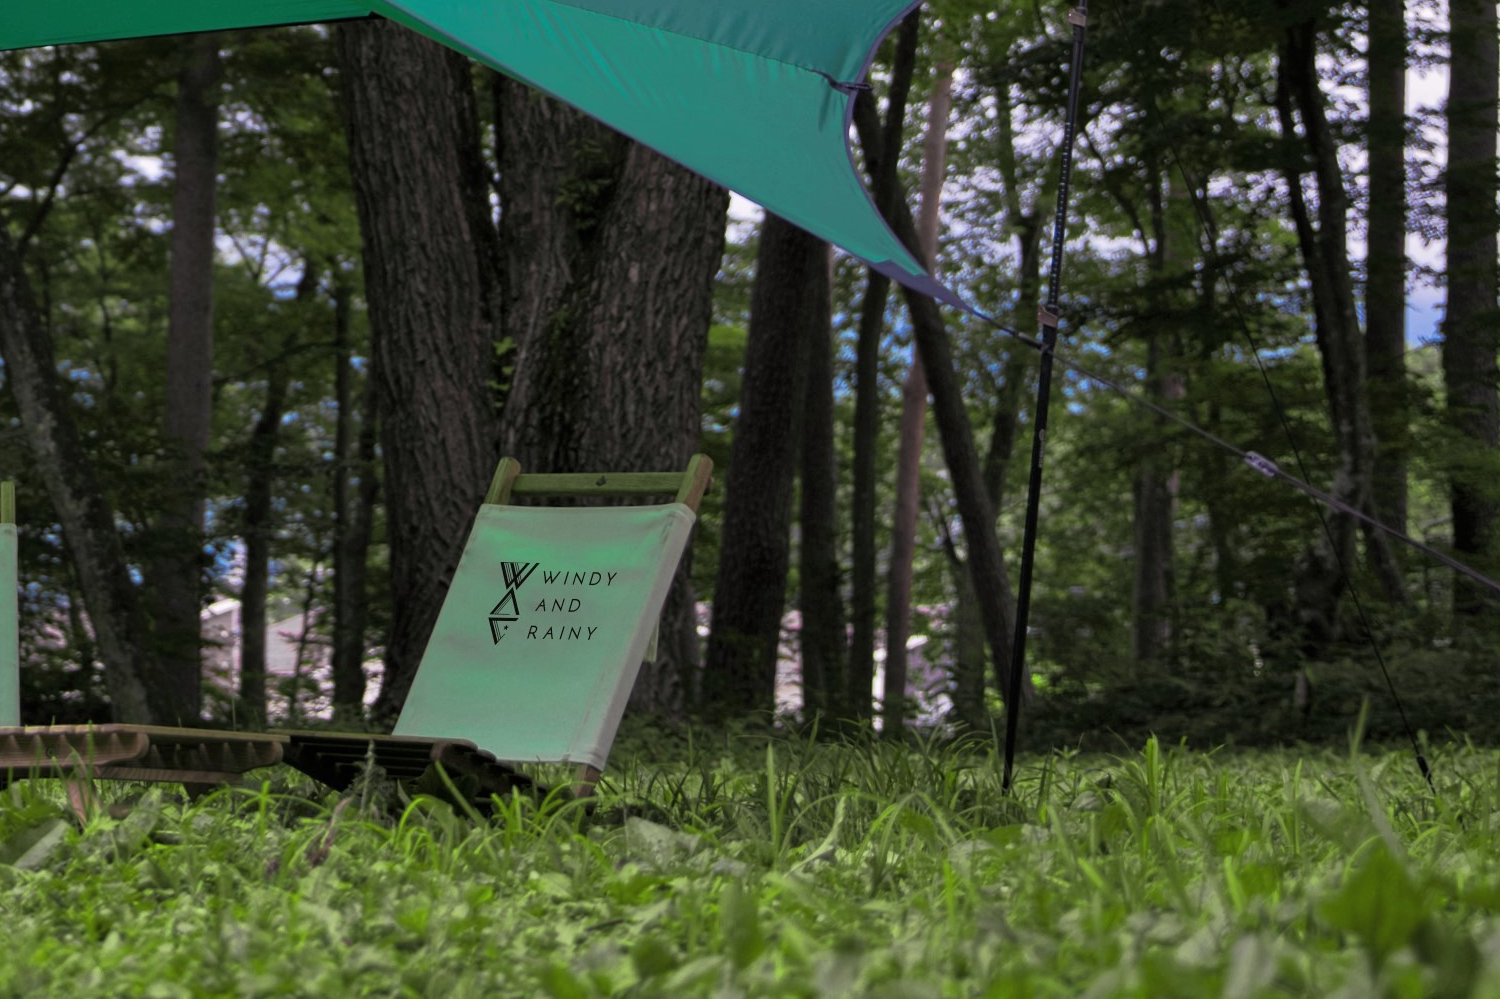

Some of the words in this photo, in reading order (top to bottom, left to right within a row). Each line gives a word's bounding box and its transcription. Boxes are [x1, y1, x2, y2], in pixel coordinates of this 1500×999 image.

[543, 570, 618, 586] WINDY
[534, 598, 581, 613] AND
[526, 625, 598, 641] RAINY
